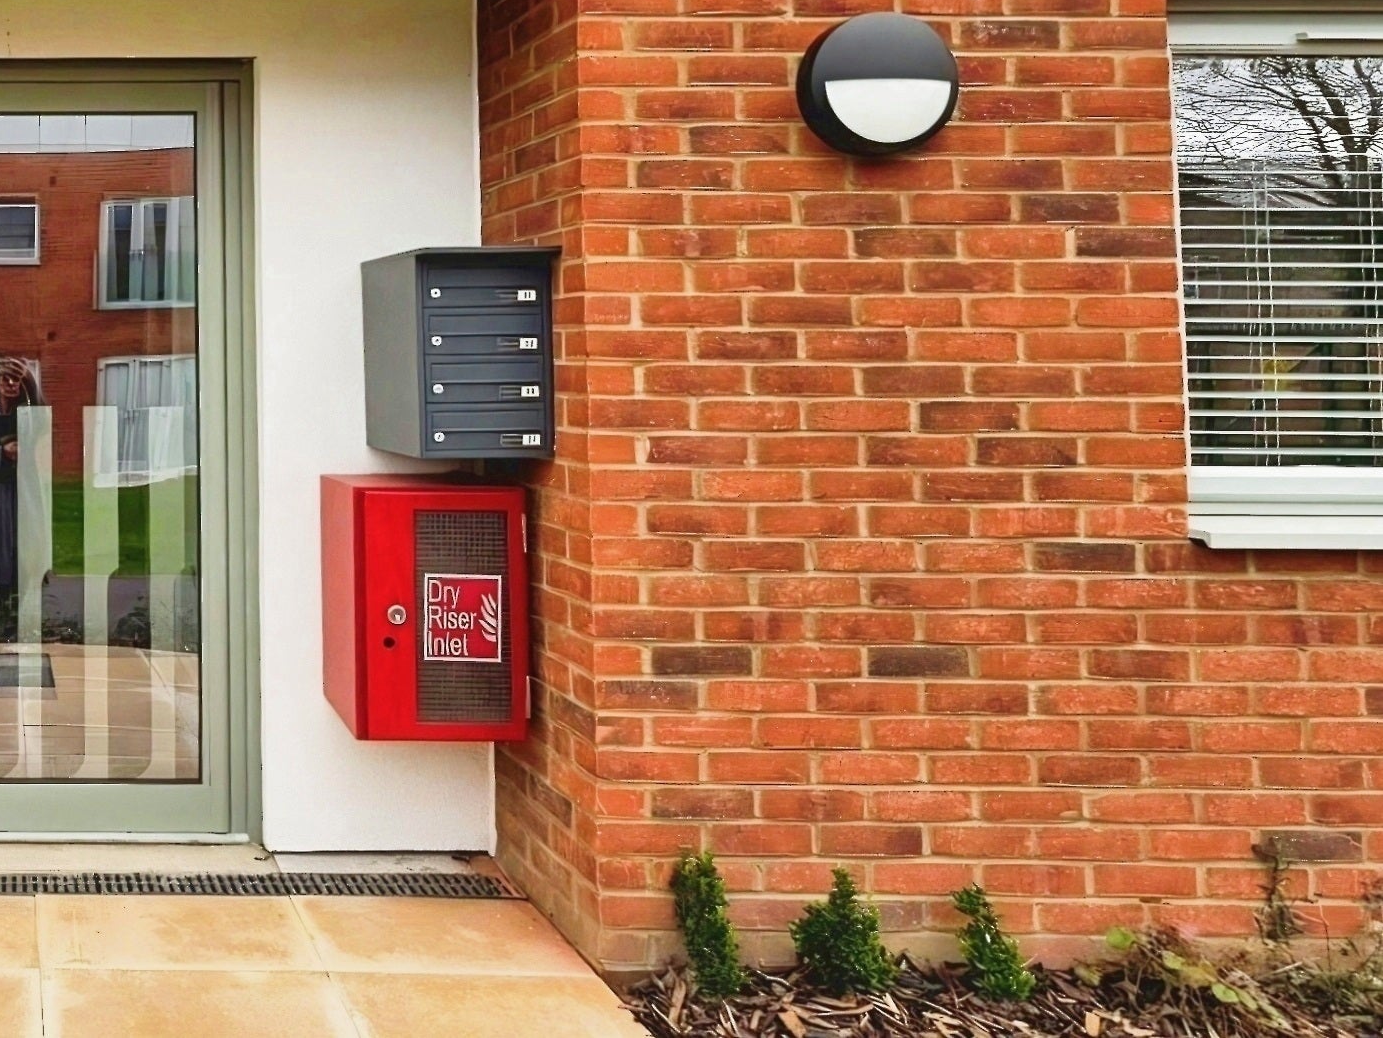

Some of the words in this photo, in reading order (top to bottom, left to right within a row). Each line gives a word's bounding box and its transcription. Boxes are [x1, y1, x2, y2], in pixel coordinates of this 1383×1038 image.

[428, 579, 460, 609] Dry
[428, 605, 477, 630] Riser
[428, 630, 469, 656] Inlet
